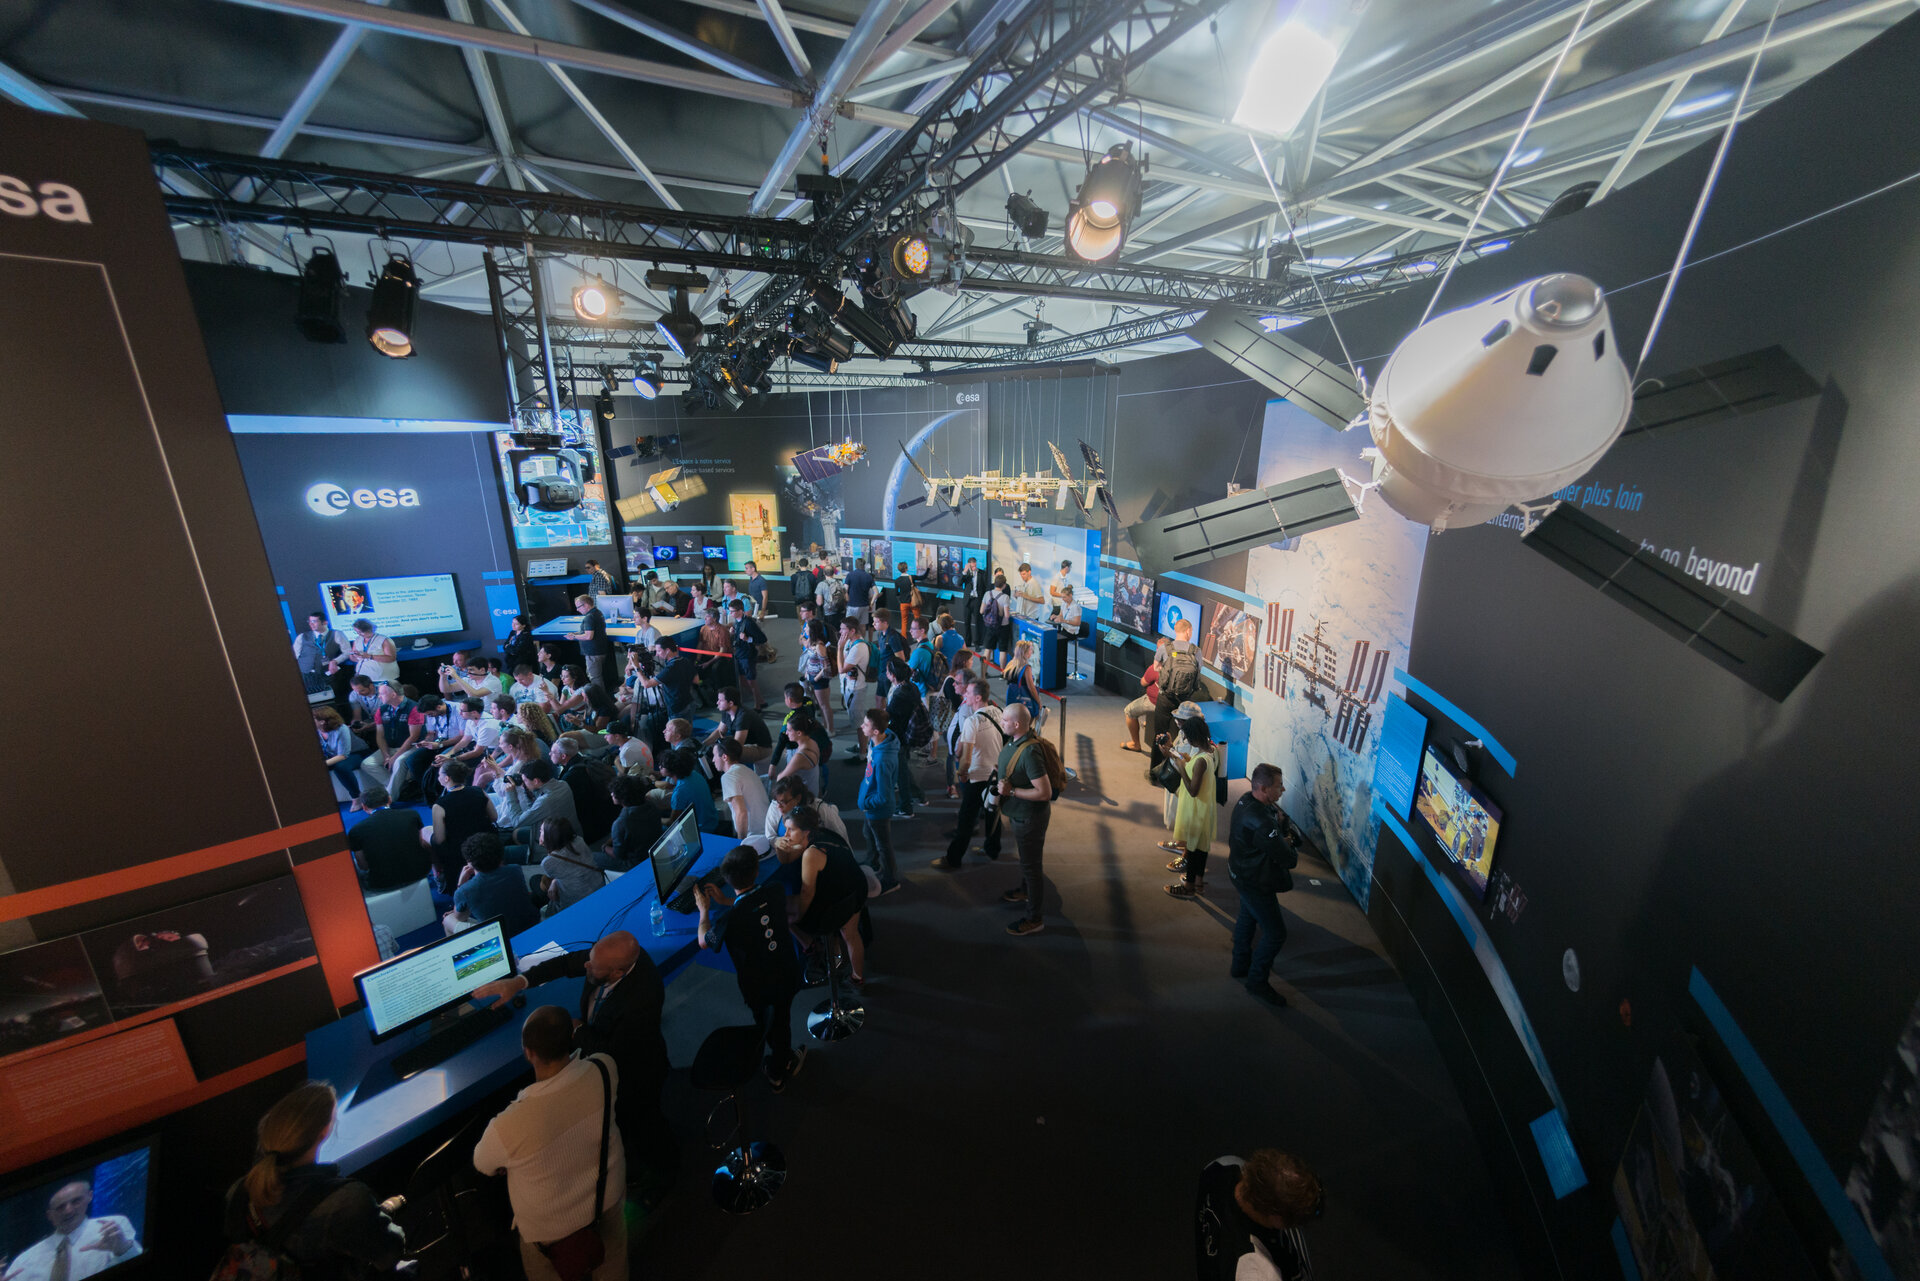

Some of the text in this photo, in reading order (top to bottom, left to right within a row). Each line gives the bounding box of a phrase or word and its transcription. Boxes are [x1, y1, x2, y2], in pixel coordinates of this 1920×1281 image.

[965, 393, 980, 402] esa
[353, 488, 421, 509] esa
[1581, 481, 1613, 509] plus
[1614, 483, 1643, 512] loin
[1684, 546, 1760, 596] beyond
